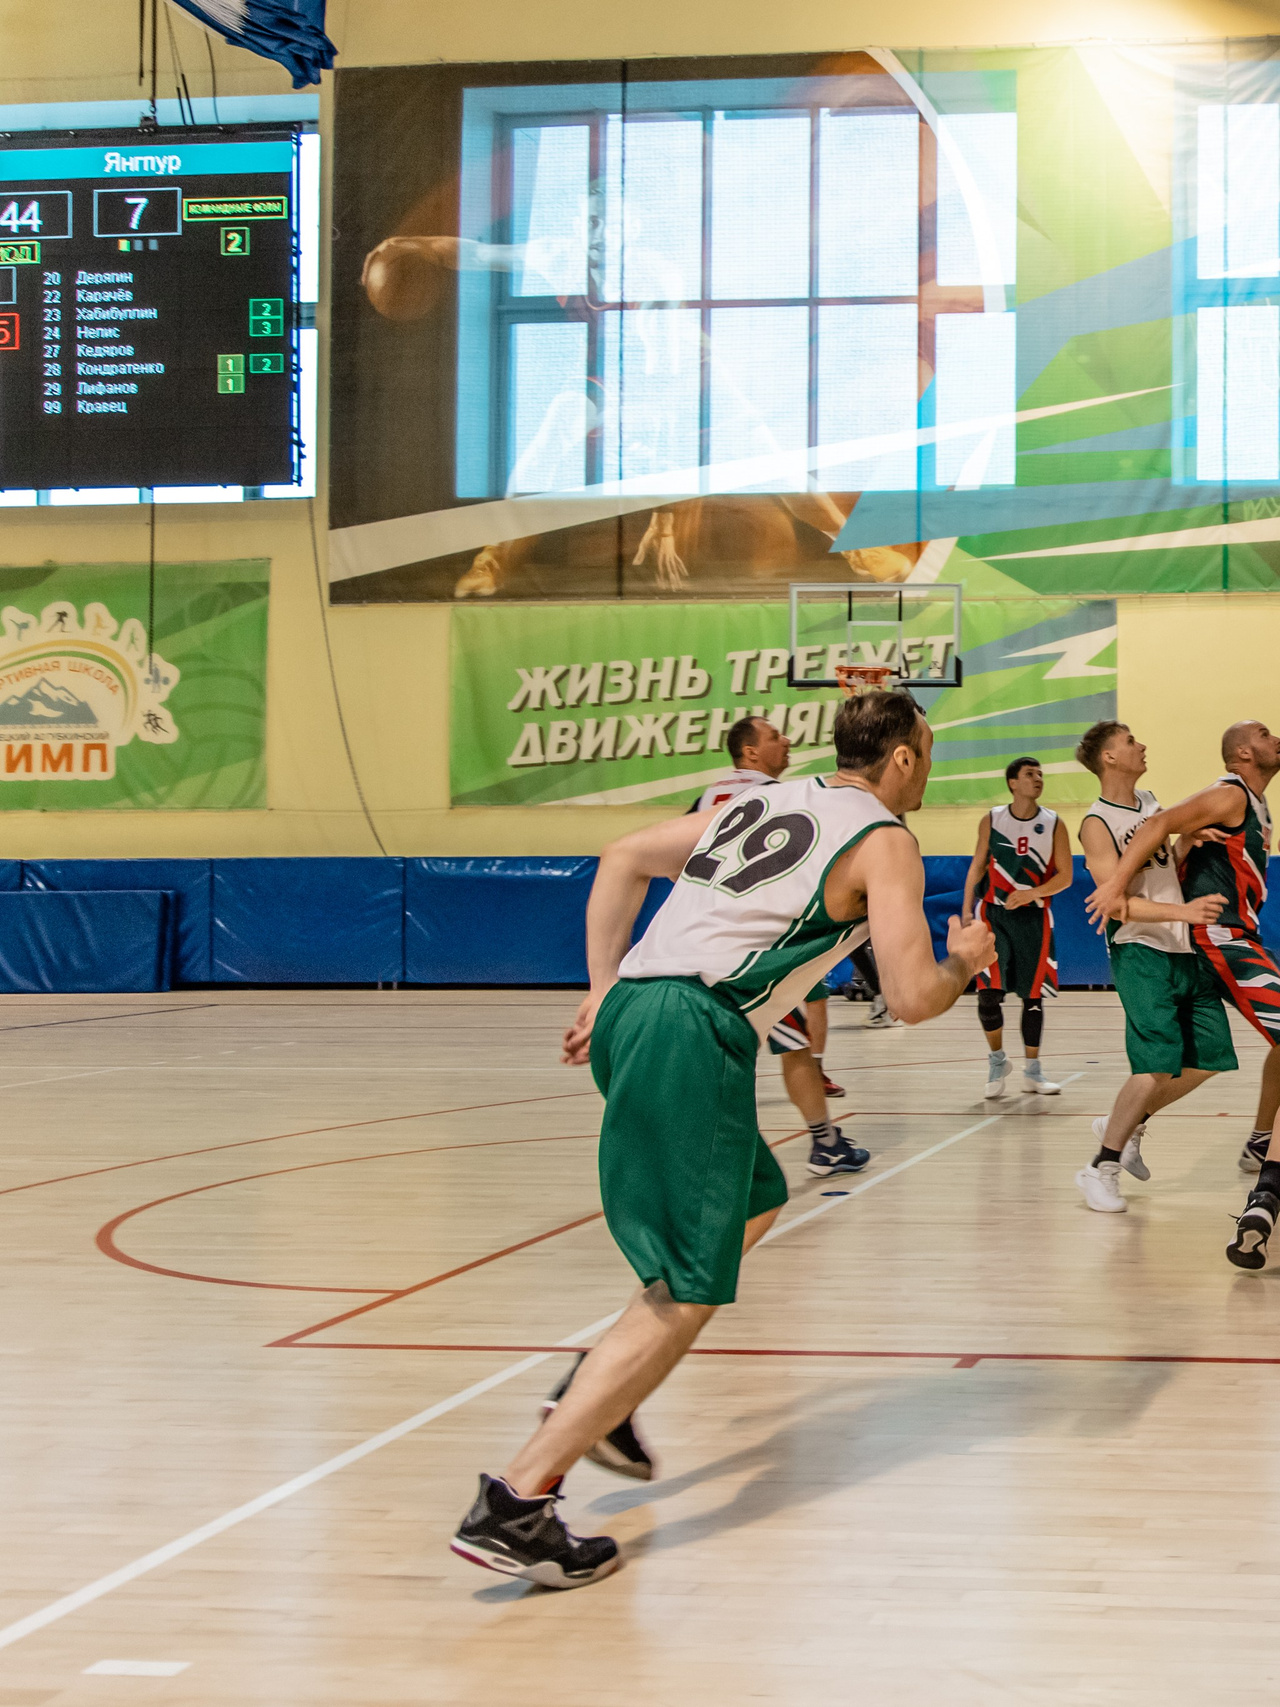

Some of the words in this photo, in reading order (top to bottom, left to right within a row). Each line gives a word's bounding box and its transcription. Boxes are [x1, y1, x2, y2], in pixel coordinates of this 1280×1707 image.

[0, 201, 43, 233] 44
[125, 197, 149, 230] 7
[227, 232, 243, 253] 2
[43, 271, 61, 285] 20
[43, 290, 61, 304] 22
[43, 308, 61, 322] 23
[261, 303, 272, 316] 2
[43, 326, 61, 340] 24
[261, 321, 272, 335] 3
[43, 345, 61, 358] 27
[43, 363, 62, 377] 28
[226, 358, 234, 372] 1
[262, 358, 272, 371] 2
[43, 382, 62, 396] 29
[226, 378, 234, 392] 1
[43, 400, 62, 414] 99
[507, 655, 711, 712] ЖИЗНЬ
[681, 796, 820, 898] 29
[1017, 836, 1029, 855] 8
